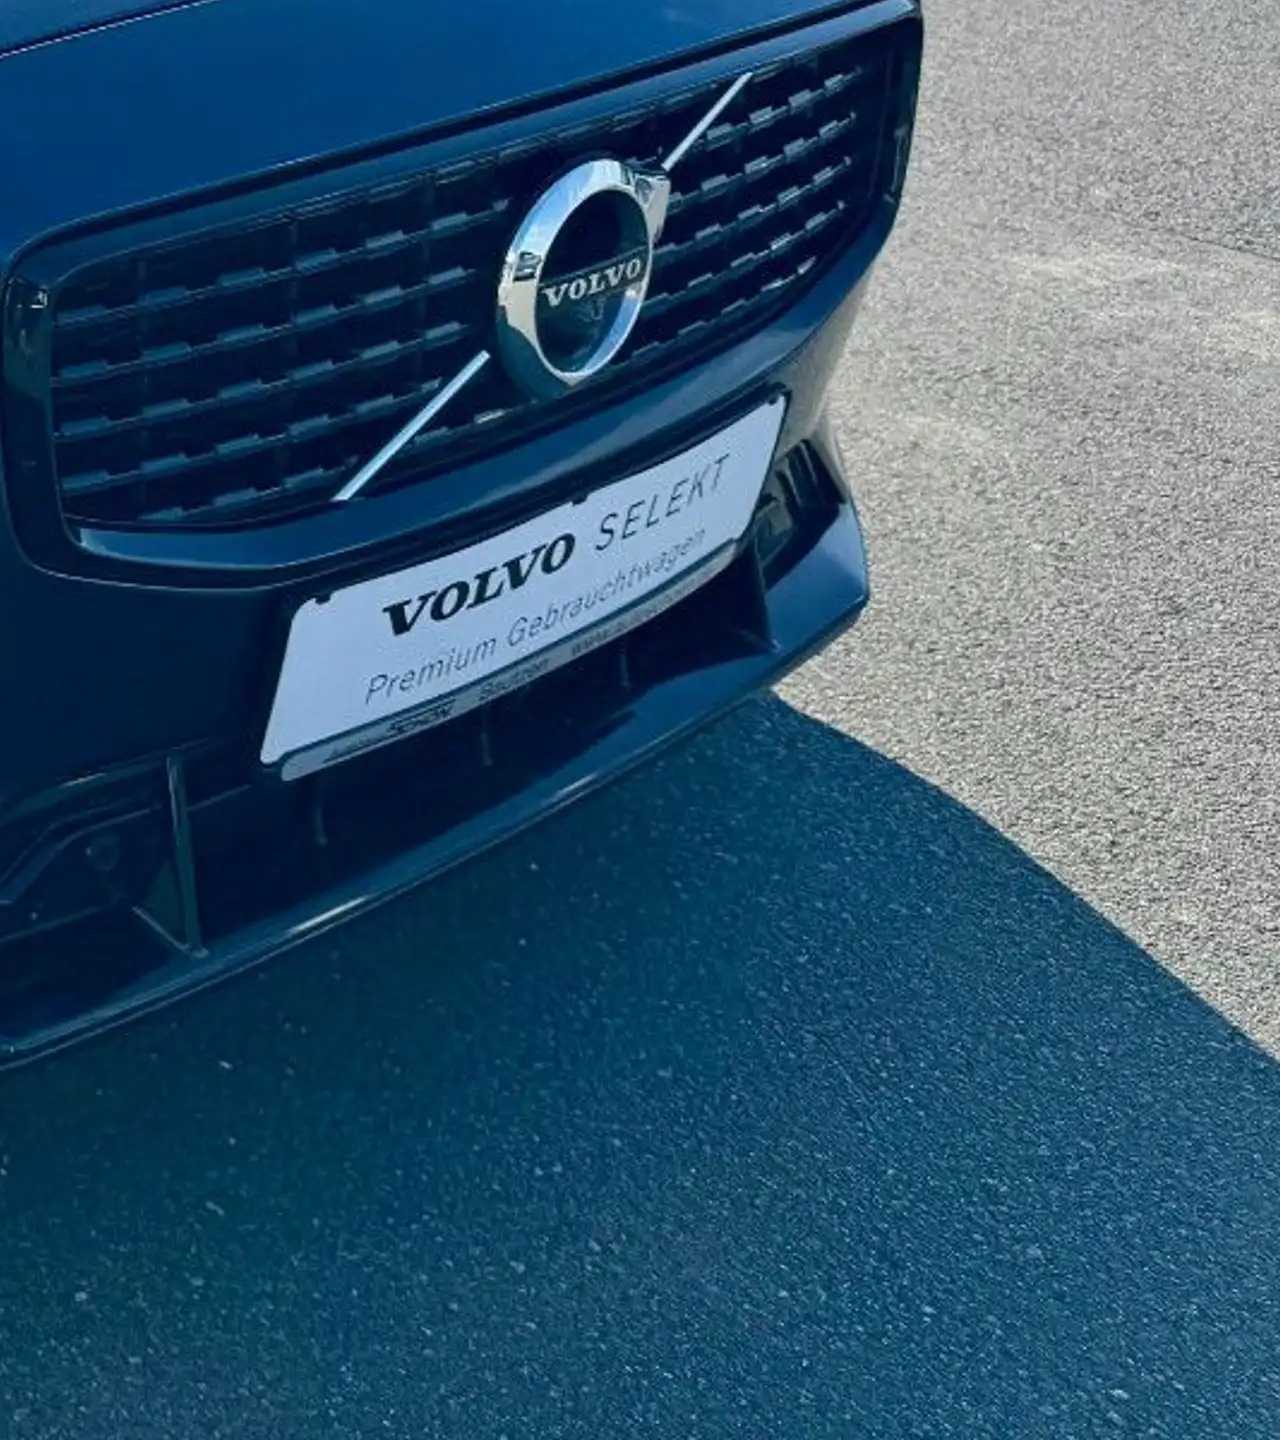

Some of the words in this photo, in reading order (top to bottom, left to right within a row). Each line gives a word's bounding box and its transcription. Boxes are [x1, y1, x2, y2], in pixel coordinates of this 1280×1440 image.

[541, 258, 641, 307] VOLVO
[365, 637, 497, 705] Premium
[505, 529, 706, 648] Gebrauchtwagen
[383, 532, 576, 636] VOLVO
[595, 453, 730, 551] SELEKT
